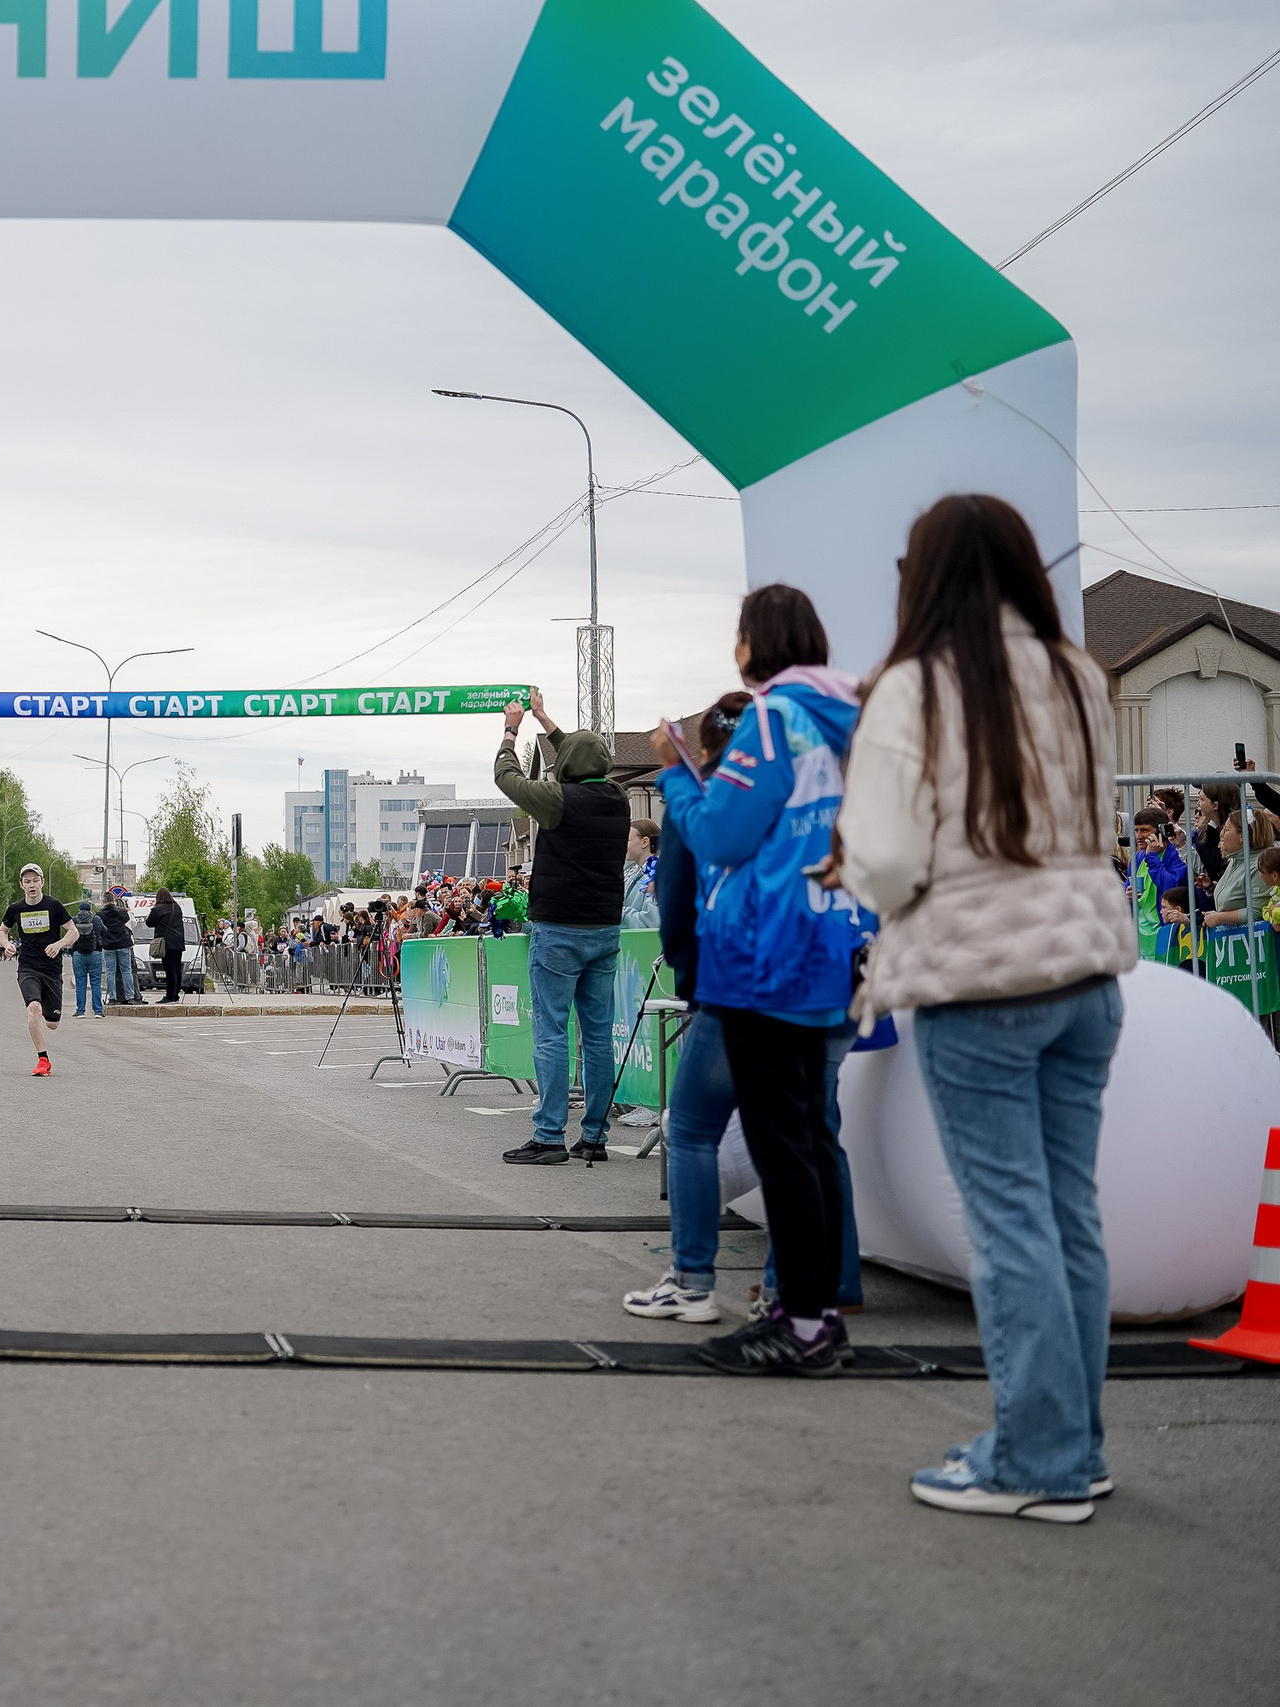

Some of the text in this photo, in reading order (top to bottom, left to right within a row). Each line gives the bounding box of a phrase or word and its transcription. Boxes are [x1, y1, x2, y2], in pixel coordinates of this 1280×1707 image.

[646, 55, 907, 288] зелёный
[599, 96, 858, 334] марафон
[13, 694, 109, 717] СТАРТ
[129, 695, 225, 717] СТАРТ
[243, 694, 339, 717] СТАРТ
[357, 690, 452, 715] СТАРТ
[460, 698, 506, 709] марафон
[466, 689, 511, 700] зелёный
[134, 900, 155, 908] 103
